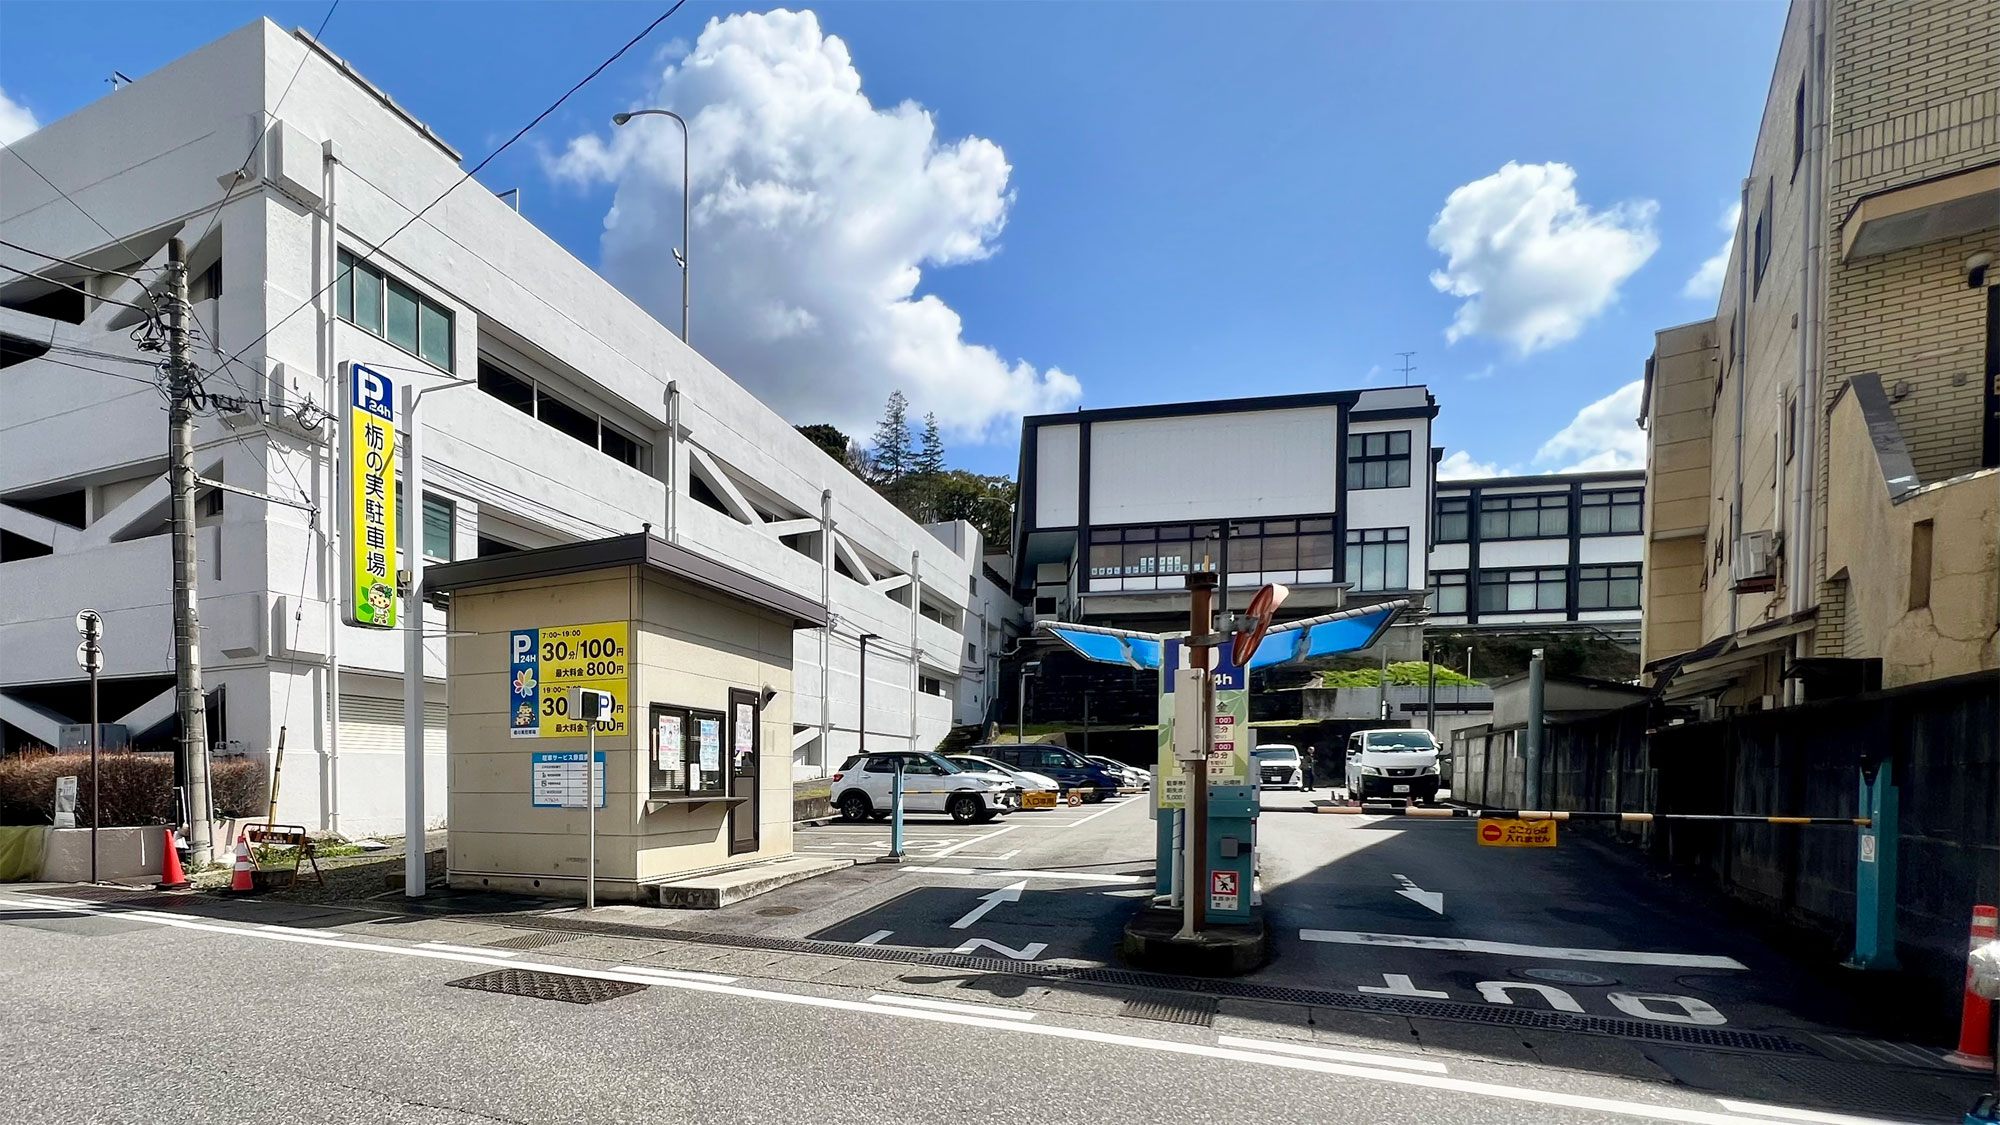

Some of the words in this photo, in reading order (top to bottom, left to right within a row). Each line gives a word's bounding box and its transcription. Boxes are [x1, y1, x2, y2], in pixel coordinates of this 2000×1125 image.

[357, 368, 384, 409] P
[368, 399, 391, 419] 24h
[364, 422, 386, 578] 栃の実駐車場
[513, 635, 532, 664] P
[520, 654, 537, 663] 24H
[555, 668, 584, 677] 最大料金
[586, 661, 624, 676] 800円
[1215, 673, 1233, 686] 4h
[599, 695, 610, 717] P
[555, 723, 584, 732] 最大料金
[1505, 834, 1551, 843] 入れません
[1508, 825, 1549, 834] ここからは
[1357, 972, 1728, 1026] OUT
